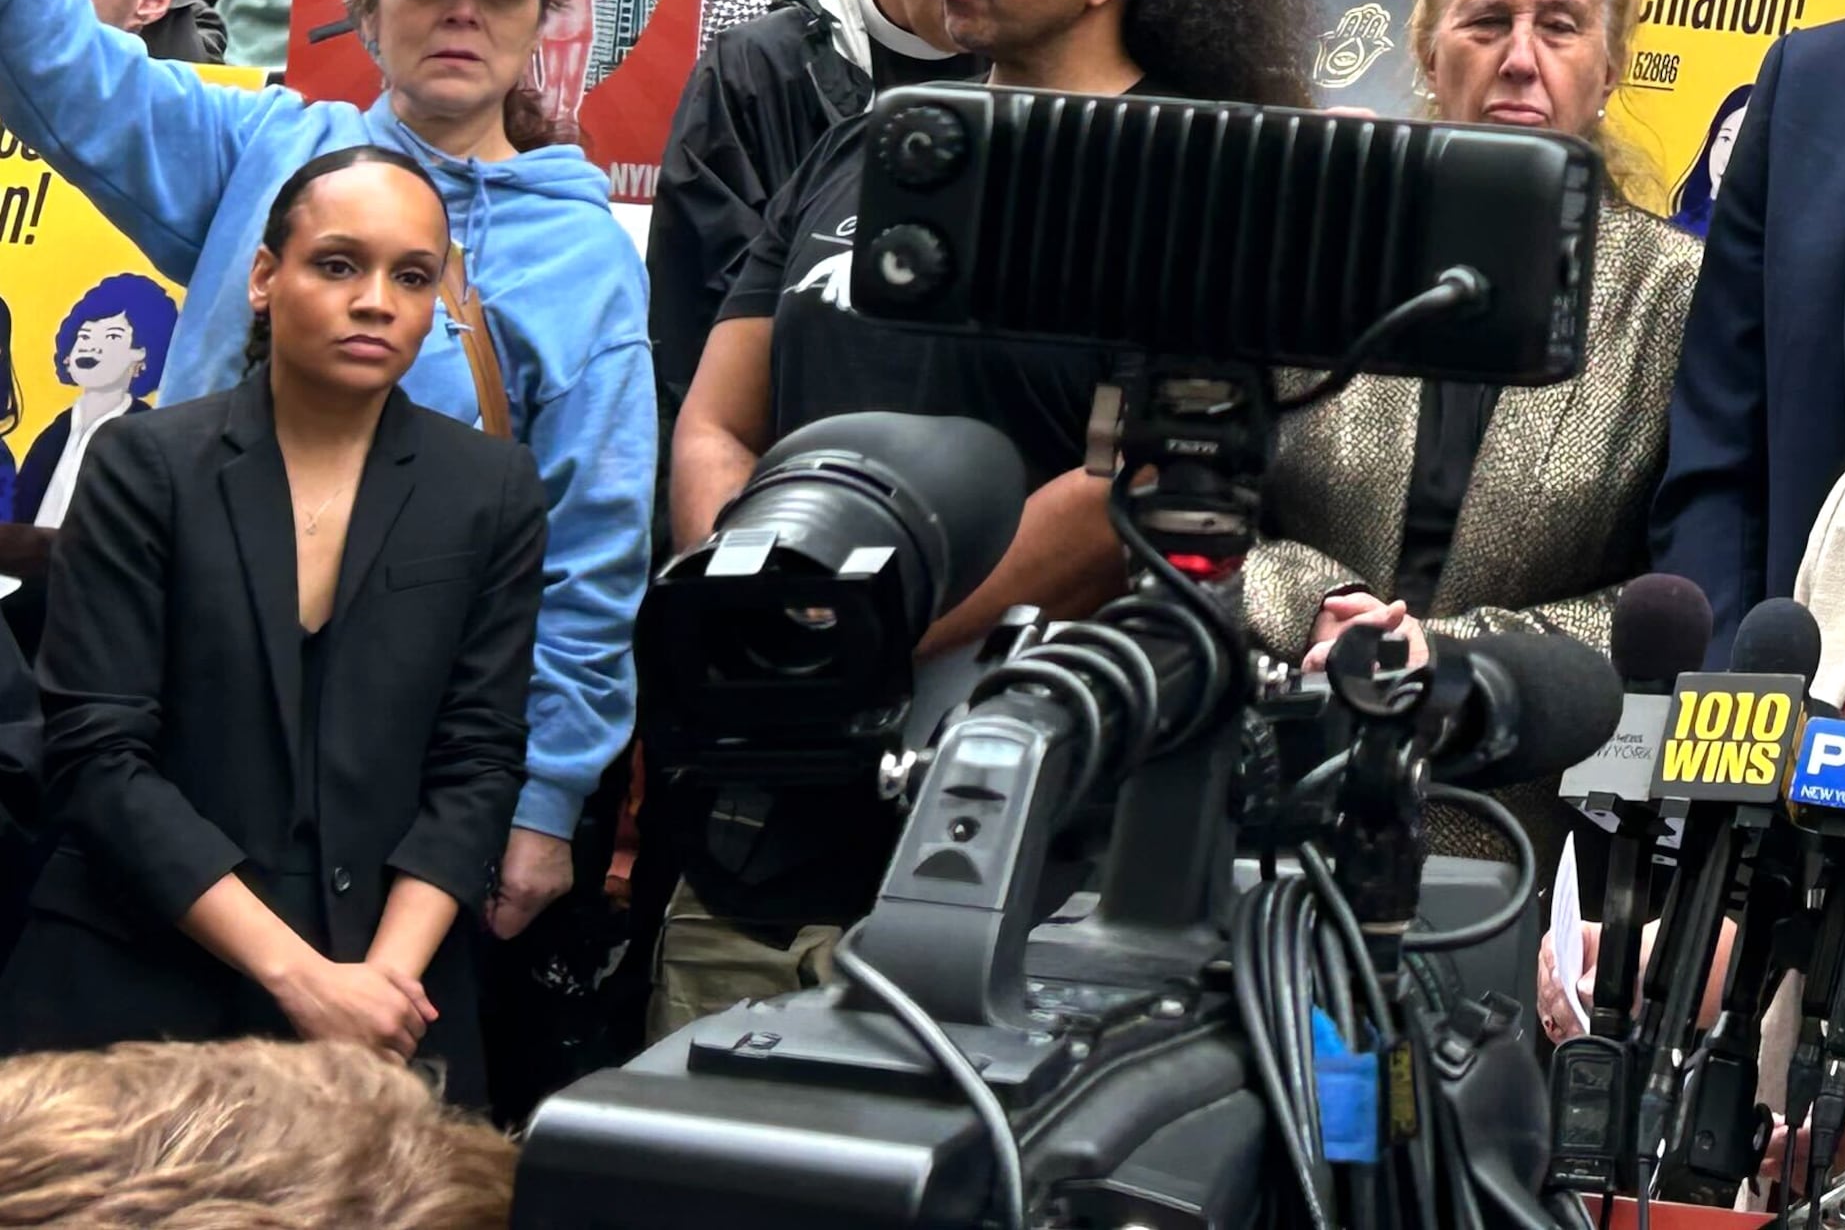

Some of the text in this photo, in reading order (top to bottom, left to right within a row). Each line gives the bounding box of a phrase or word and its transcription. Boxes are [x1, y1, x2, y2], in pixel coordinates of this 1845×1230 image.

[1633, 51, 1681, 84] 52886
[1677, 690, 1793, 740] 1010
[1662, 739, 1785, 786] WINS
[1800, 784, 1834, 802] NEW
